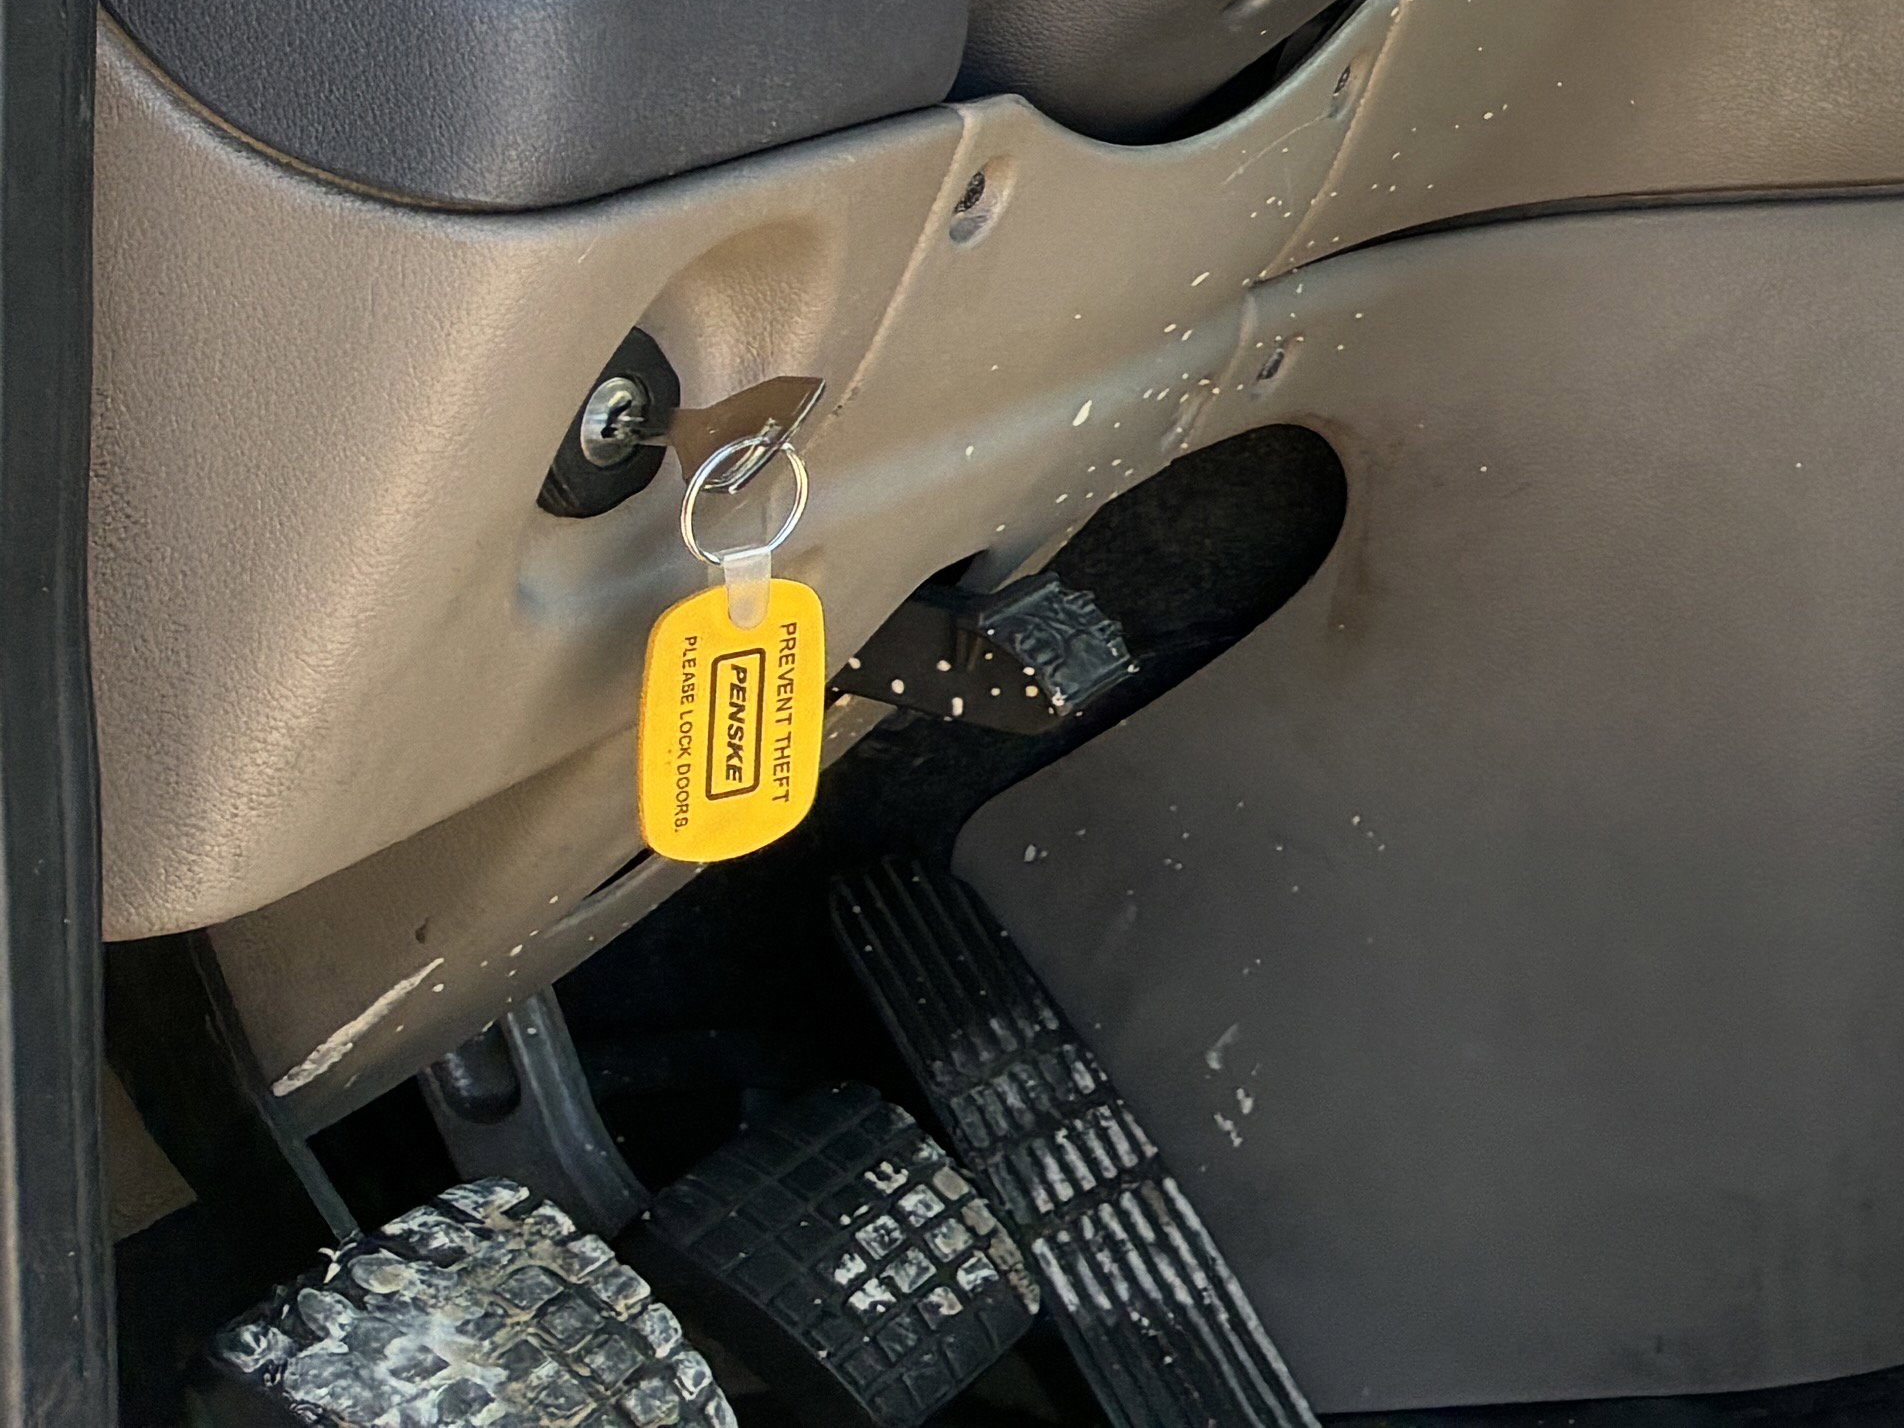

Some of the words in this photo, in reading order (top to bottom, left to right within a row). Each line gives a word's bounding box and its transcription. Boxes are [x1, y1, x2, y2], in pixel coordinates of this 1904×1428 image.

[774, 622, 797, 726] PREVENT
[675, 710, 694, 760] LOCK
[725, 663, 748, 784] PENSKE
[772, 732, 792, 803] THEFT
